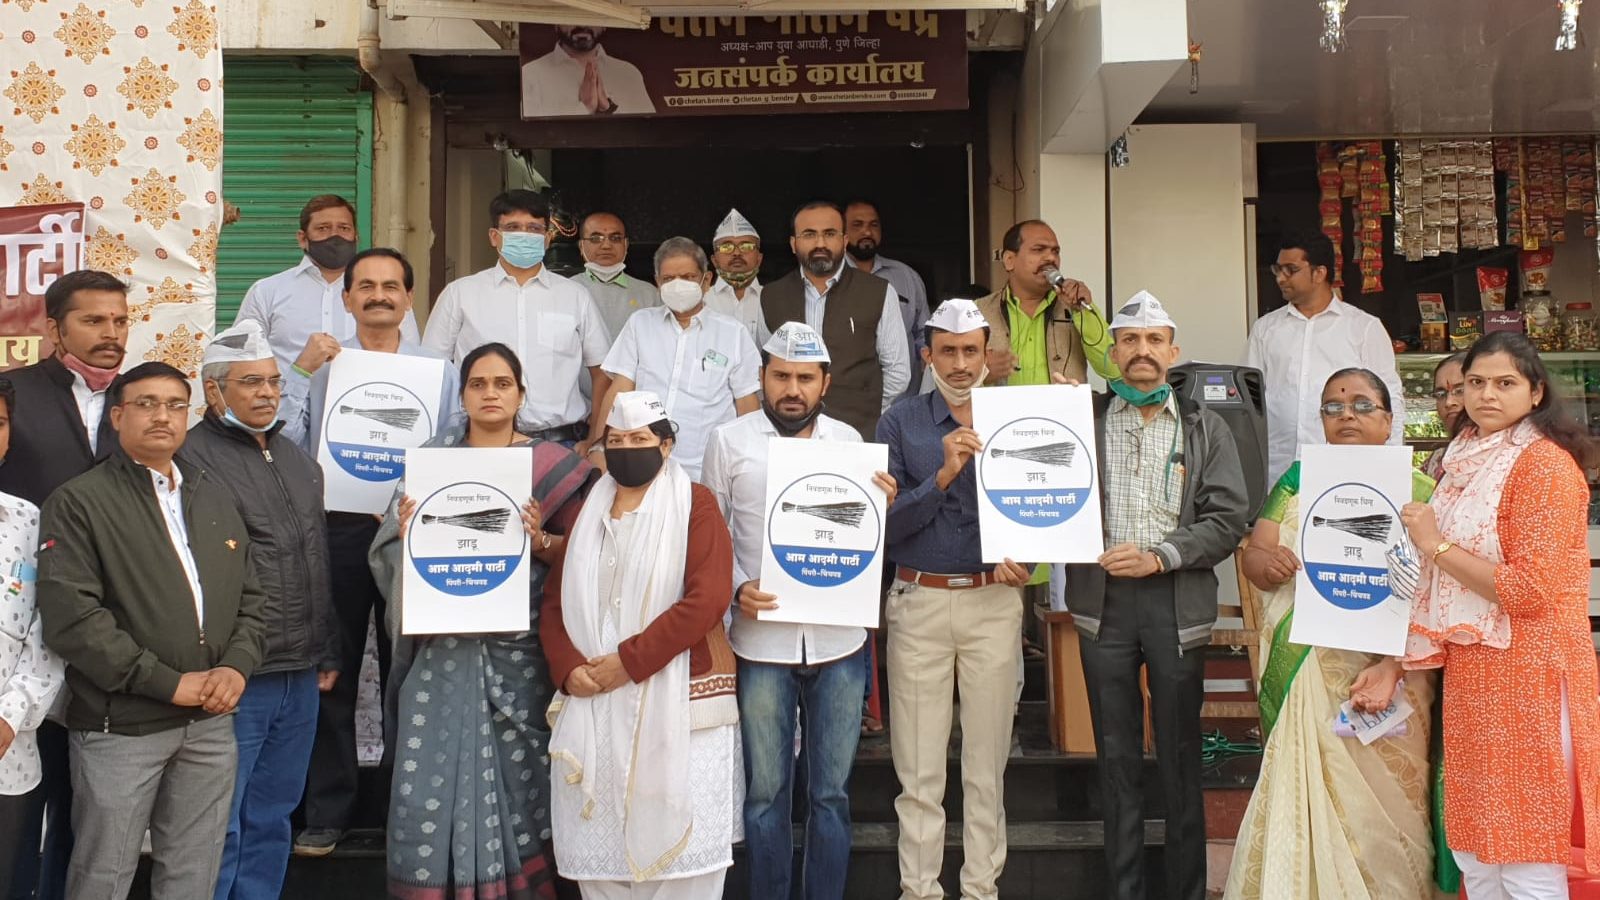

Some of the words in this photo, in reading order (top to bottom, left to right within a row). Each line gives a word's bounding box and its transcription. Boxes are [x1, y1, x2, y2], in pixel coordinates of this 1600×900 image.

[776, 40, 793, 53] युवा
[835, 36, 850, 52] पुणे
[853, 35, 881, 49] जिल्हा
[673, 55, 799, 89] जनसंपर्क
[805, 53, 925, 85] कार्यालय
[340, 449, 359, 459] आम
[362, 450, 390, 463] आदमी
[1002, 495, 1021, 505] आम
[1024, 494, 1053, 507] आदमी
[1055, 492, 1076, 504] पार्टी
[815, 529, 835, 543] झाडू
[457, 538, 479, 551] झाडू
[1344, 545, 1363, 560] झाडू
[428, 563, 449, 573] आम
[452, 561, 483, 574] आदमी
[485, 560, 506, 572] पार्टी
[786, 553, 805, 563] आम
[809, 553, 837, 567] आदमी
[840, 554, 860, 566] पार्टी
[1318, 571, 1336, 582] आम
[1339, 571, 1367, 586] आदमी
[1369, 573, 1388, 587] पार्टी
